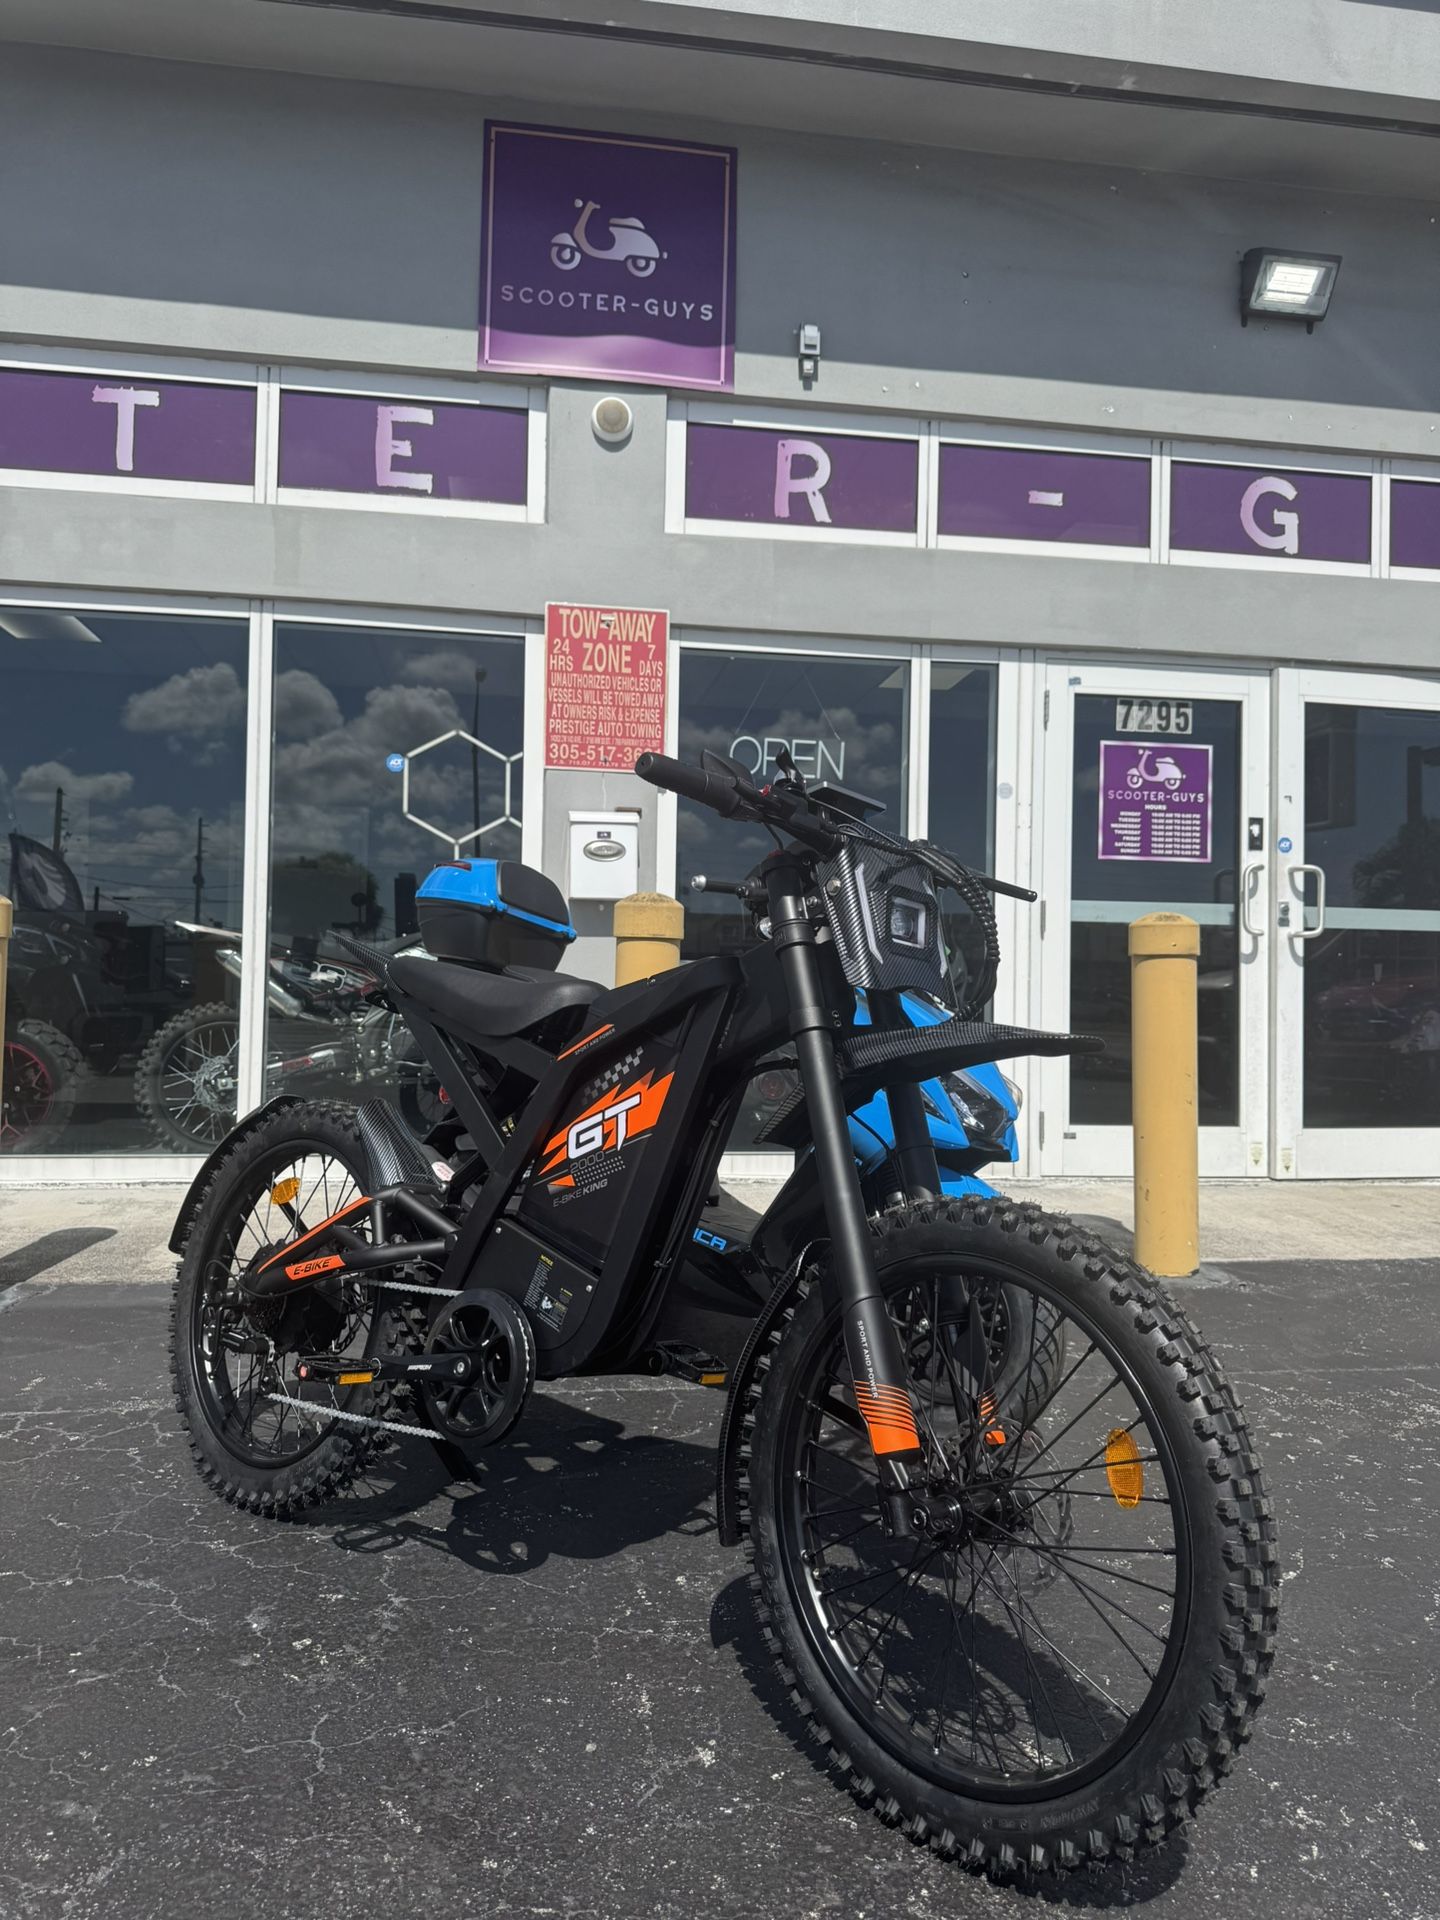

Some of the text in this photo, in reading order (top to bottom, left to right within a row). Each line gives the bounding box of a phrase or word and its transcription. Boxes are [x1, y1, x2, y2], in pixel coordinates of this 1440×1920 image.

[501, 285, 714, 321] SCOOTER-GUYS
[553, 638, 570, 654] 24
[648, 644, 656, 660] 7
[550, 654, 574, 672] HRS
[582, 642, 632, 674] ZONE
[639, 660, 664, 677] DAYS
[551, 672, 662, 692] UNAUTHORIZED VEHICLES OR
[548, 688, 664, 708] VESSELS WILL BE TOWED AWAY
[551, 704, 562, 718] AT
[563, 704, 598, 720] OWNERS
[599, 706, 616, 721] RISK
[624, 708, 660, 723] EXPENSE
[1118, 700, 1190, 732] 7295
[549, 719, 662, 738] PRESTIGE AUTO TOWING
[729, 736, 845, 781] OPEN
[1108, 790, 1204, 802] SCOOTER-GUYS
[568, 1093, 640, 1160] GT
[294, 1260, 330, 1276] E-BIKE
[857, 1320, 879, 1398] SPORT AND POWER
